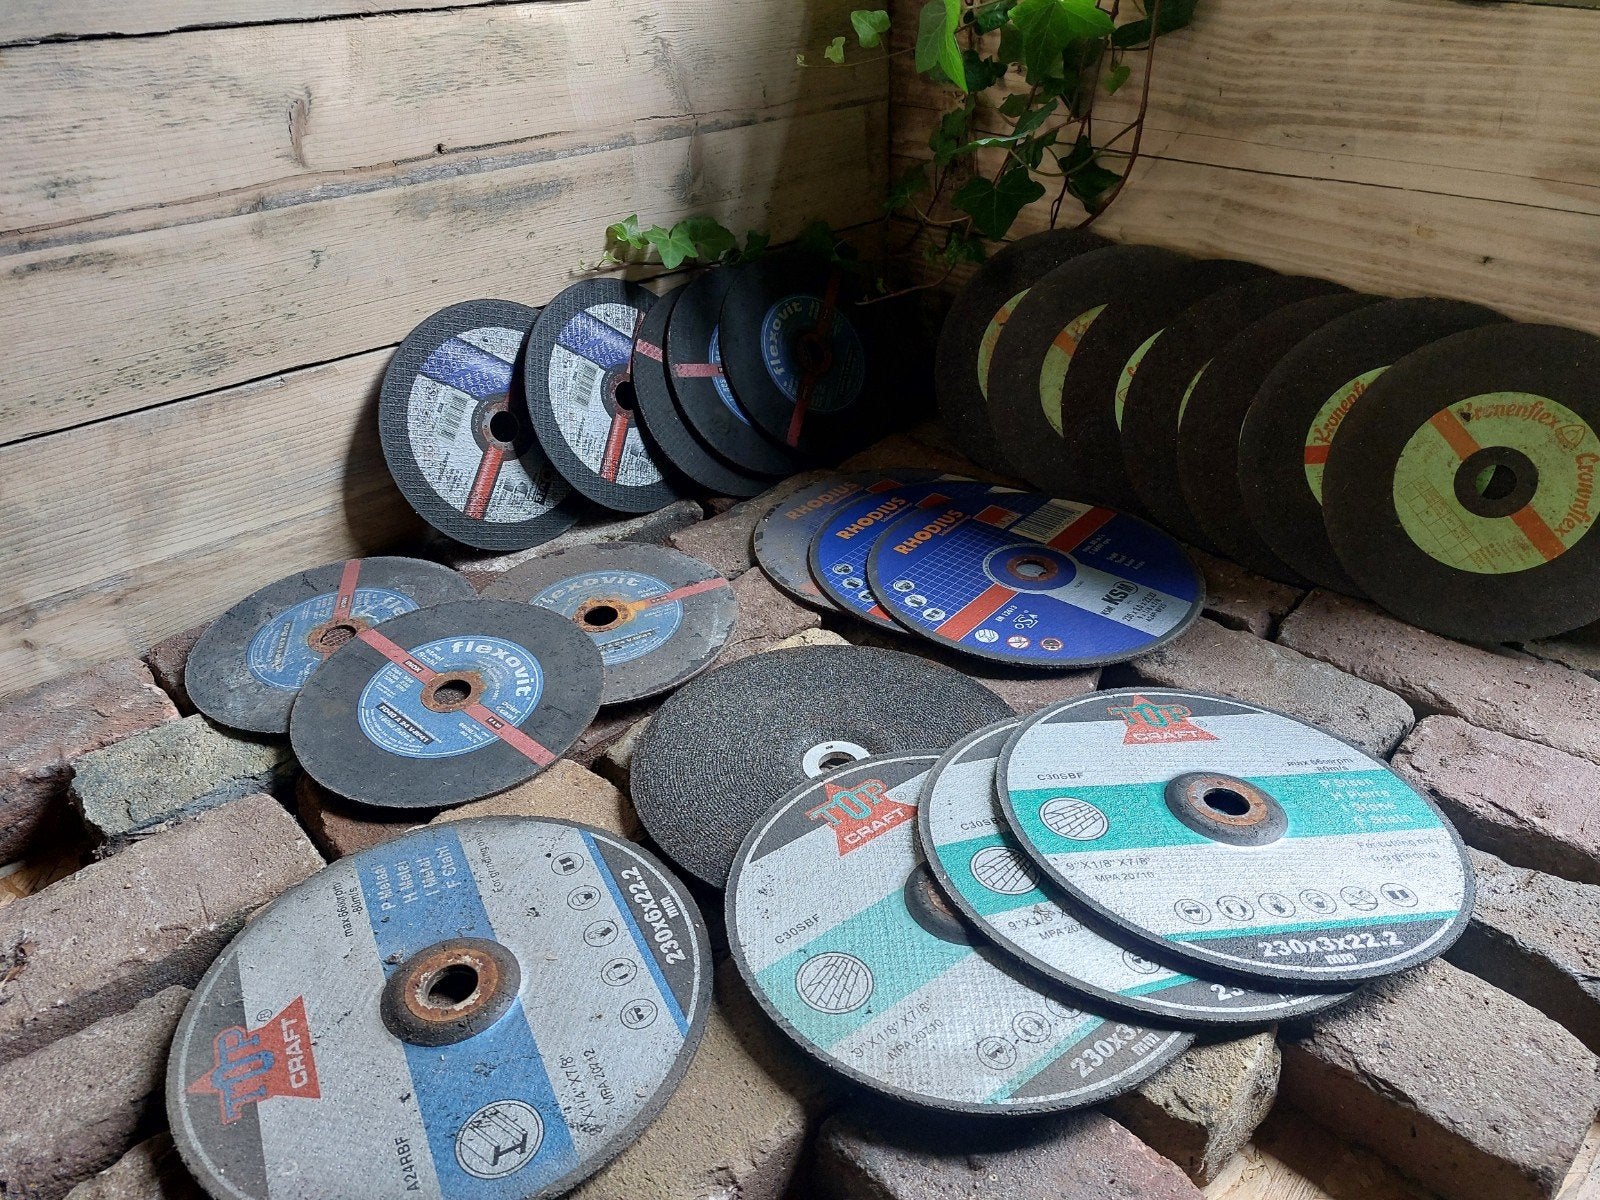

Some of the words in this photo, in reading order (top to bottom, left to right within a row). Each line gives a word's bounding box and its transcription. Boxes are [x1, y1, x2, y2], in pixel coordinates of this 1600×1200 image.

[770, 301, 803, 375] flexovit
[785, 481, 860, 521] RHODIUS
[1554, 453, 1600, 537] Crownflex
[836, 495, 908, 540] RHODIUS
[893, 508, 966, 555] RHODIUS
[452, 640, 535, 697] flexovit
[1109, 703, 1190, 728] TOP
[1132, 730, 1199, 742] CRAFT
[1037, 772, 1085, 781] C30SBF
[809, 782, 885, 827] TOP
[843, 808, 906, 845] CRAFT
[435, 845, 457, 877] Stahl
[621, 866, 687, 965] 230x6x22.2
[660, 895, 680, 918] mm
[774, 914, 821, 944] C30SBF
[1038, 927, 1065, 940] MPA
[1258, 931, 1404, 957] 230x3x22.2
[1324, 953, 1358, 965] mm
[280, 1018, 308, 1089] CRAFT
[886, 1038, 914, 1060] MPA
[1070, 1023, 1143, 1078] 230x3
[1131, 1032, 1160, 1056] mm
[210, 1029, 276, 1118] TOP
[394, 1136, 421, 1191] A24RBF
